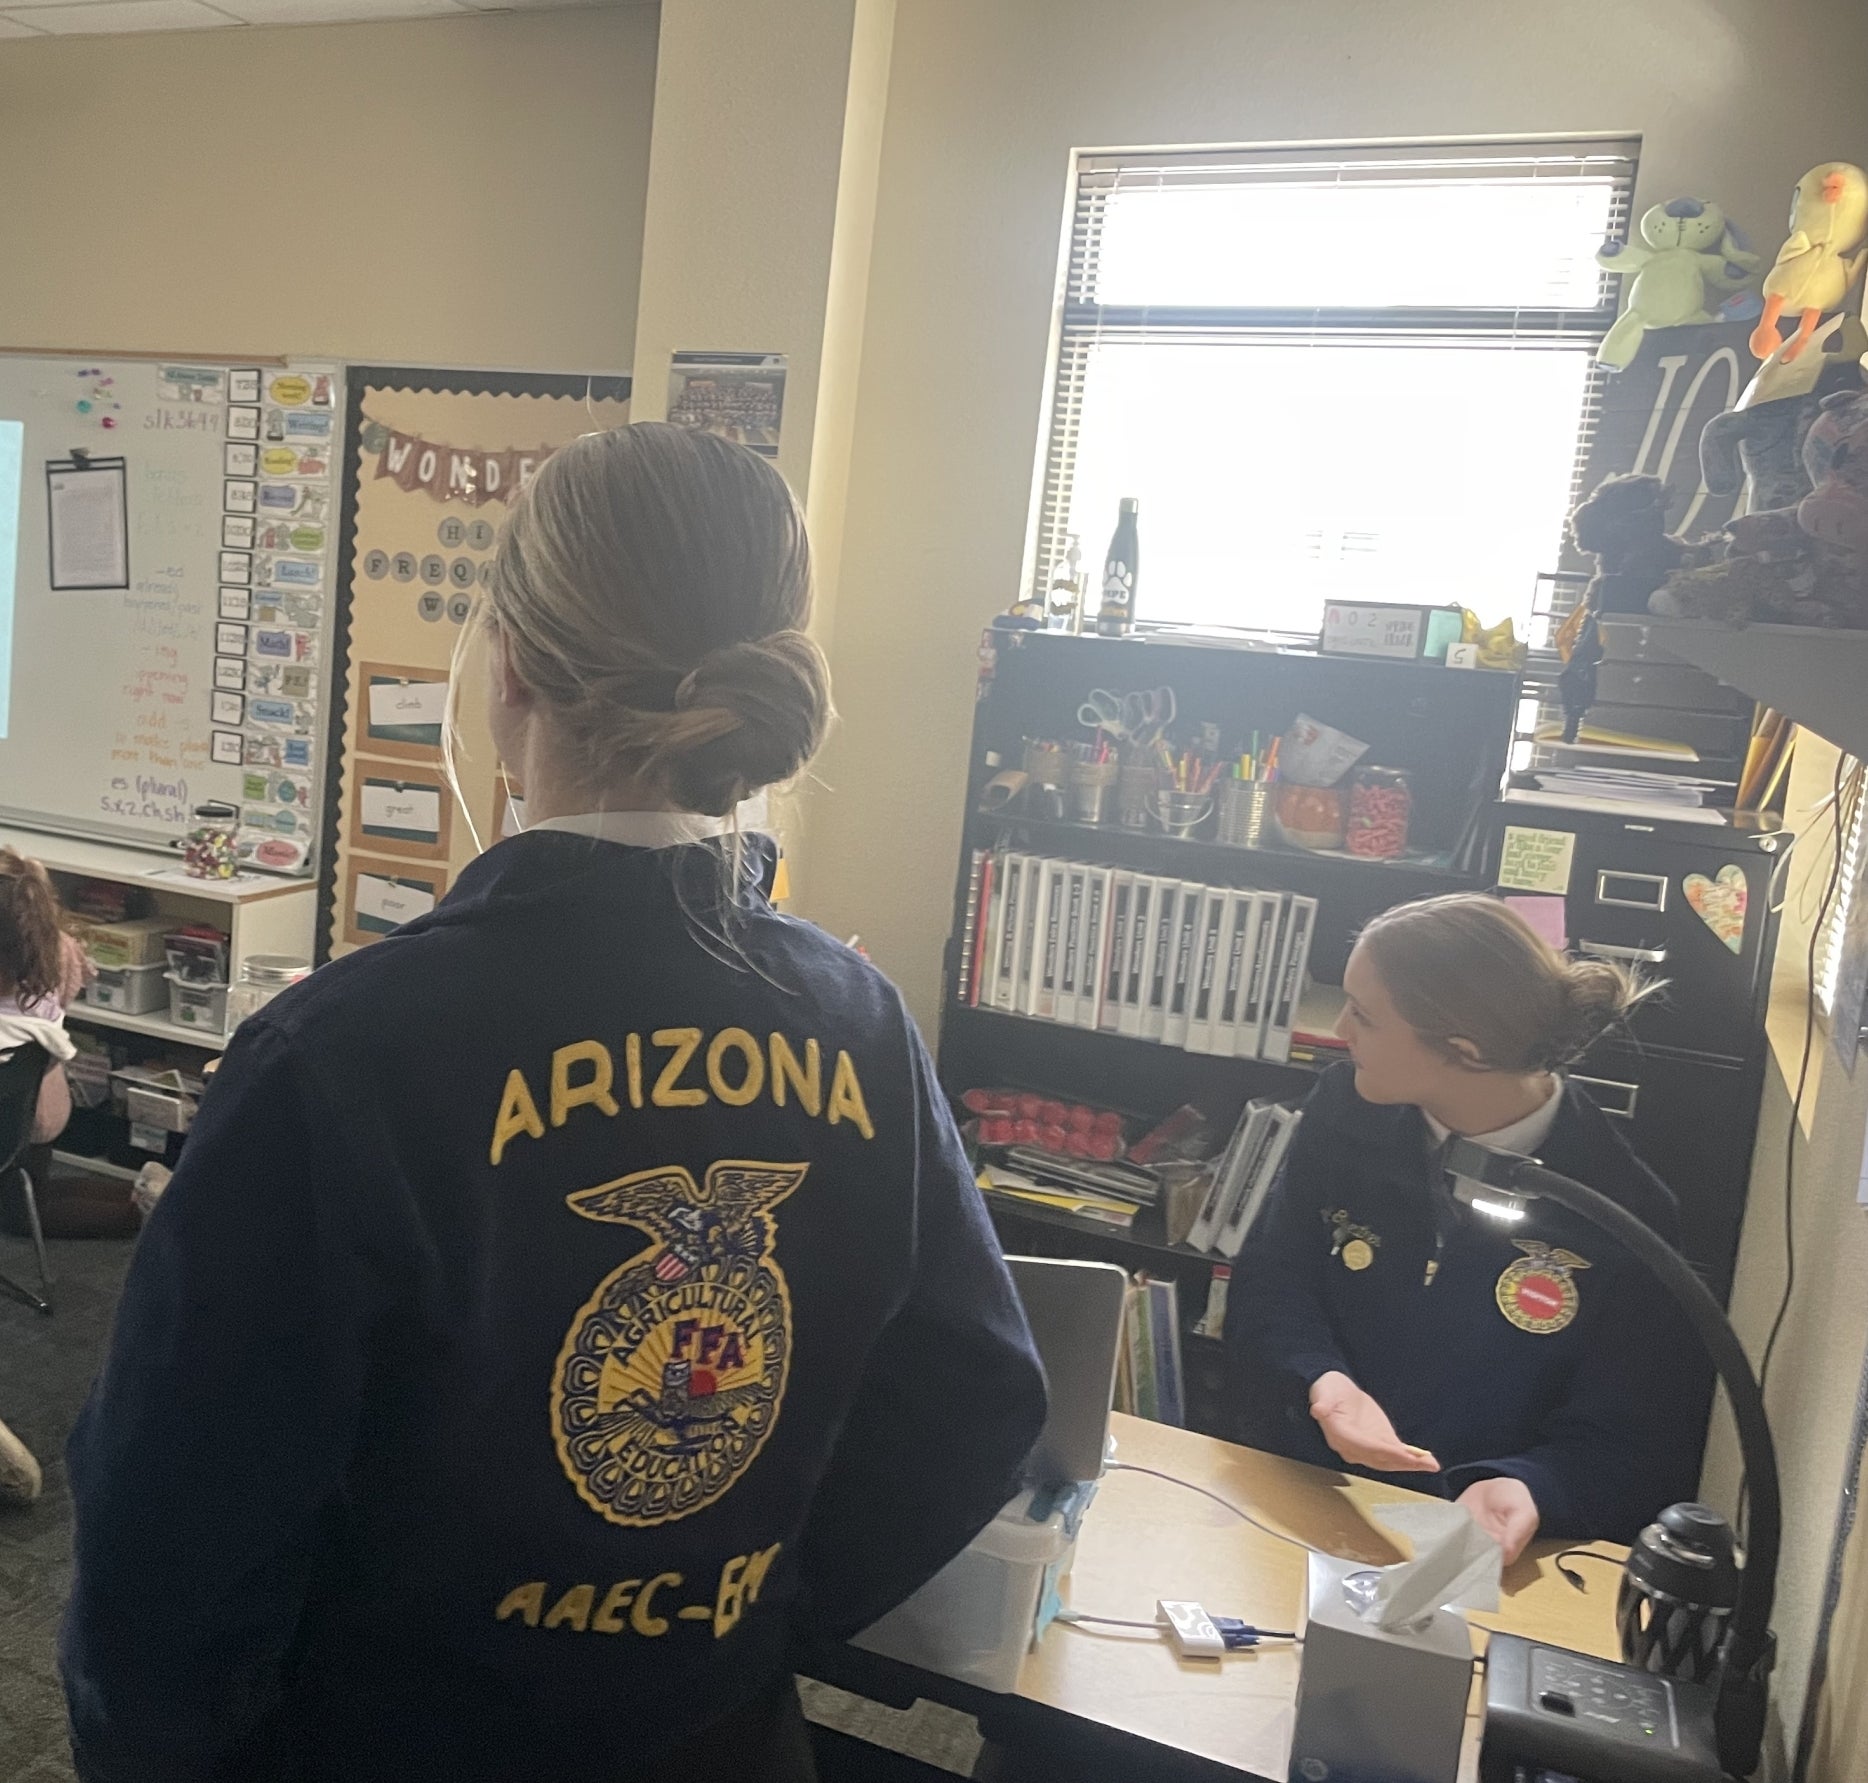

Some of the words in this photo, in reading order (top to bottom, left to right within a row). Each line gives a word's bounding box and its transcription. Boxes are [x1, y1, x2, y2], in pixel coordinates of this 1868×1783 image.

[446, 525, 483, 540] HI
[491, 1027, 875, 1165] ARIZONA
[670, 1318, 745, 1370] FFA
